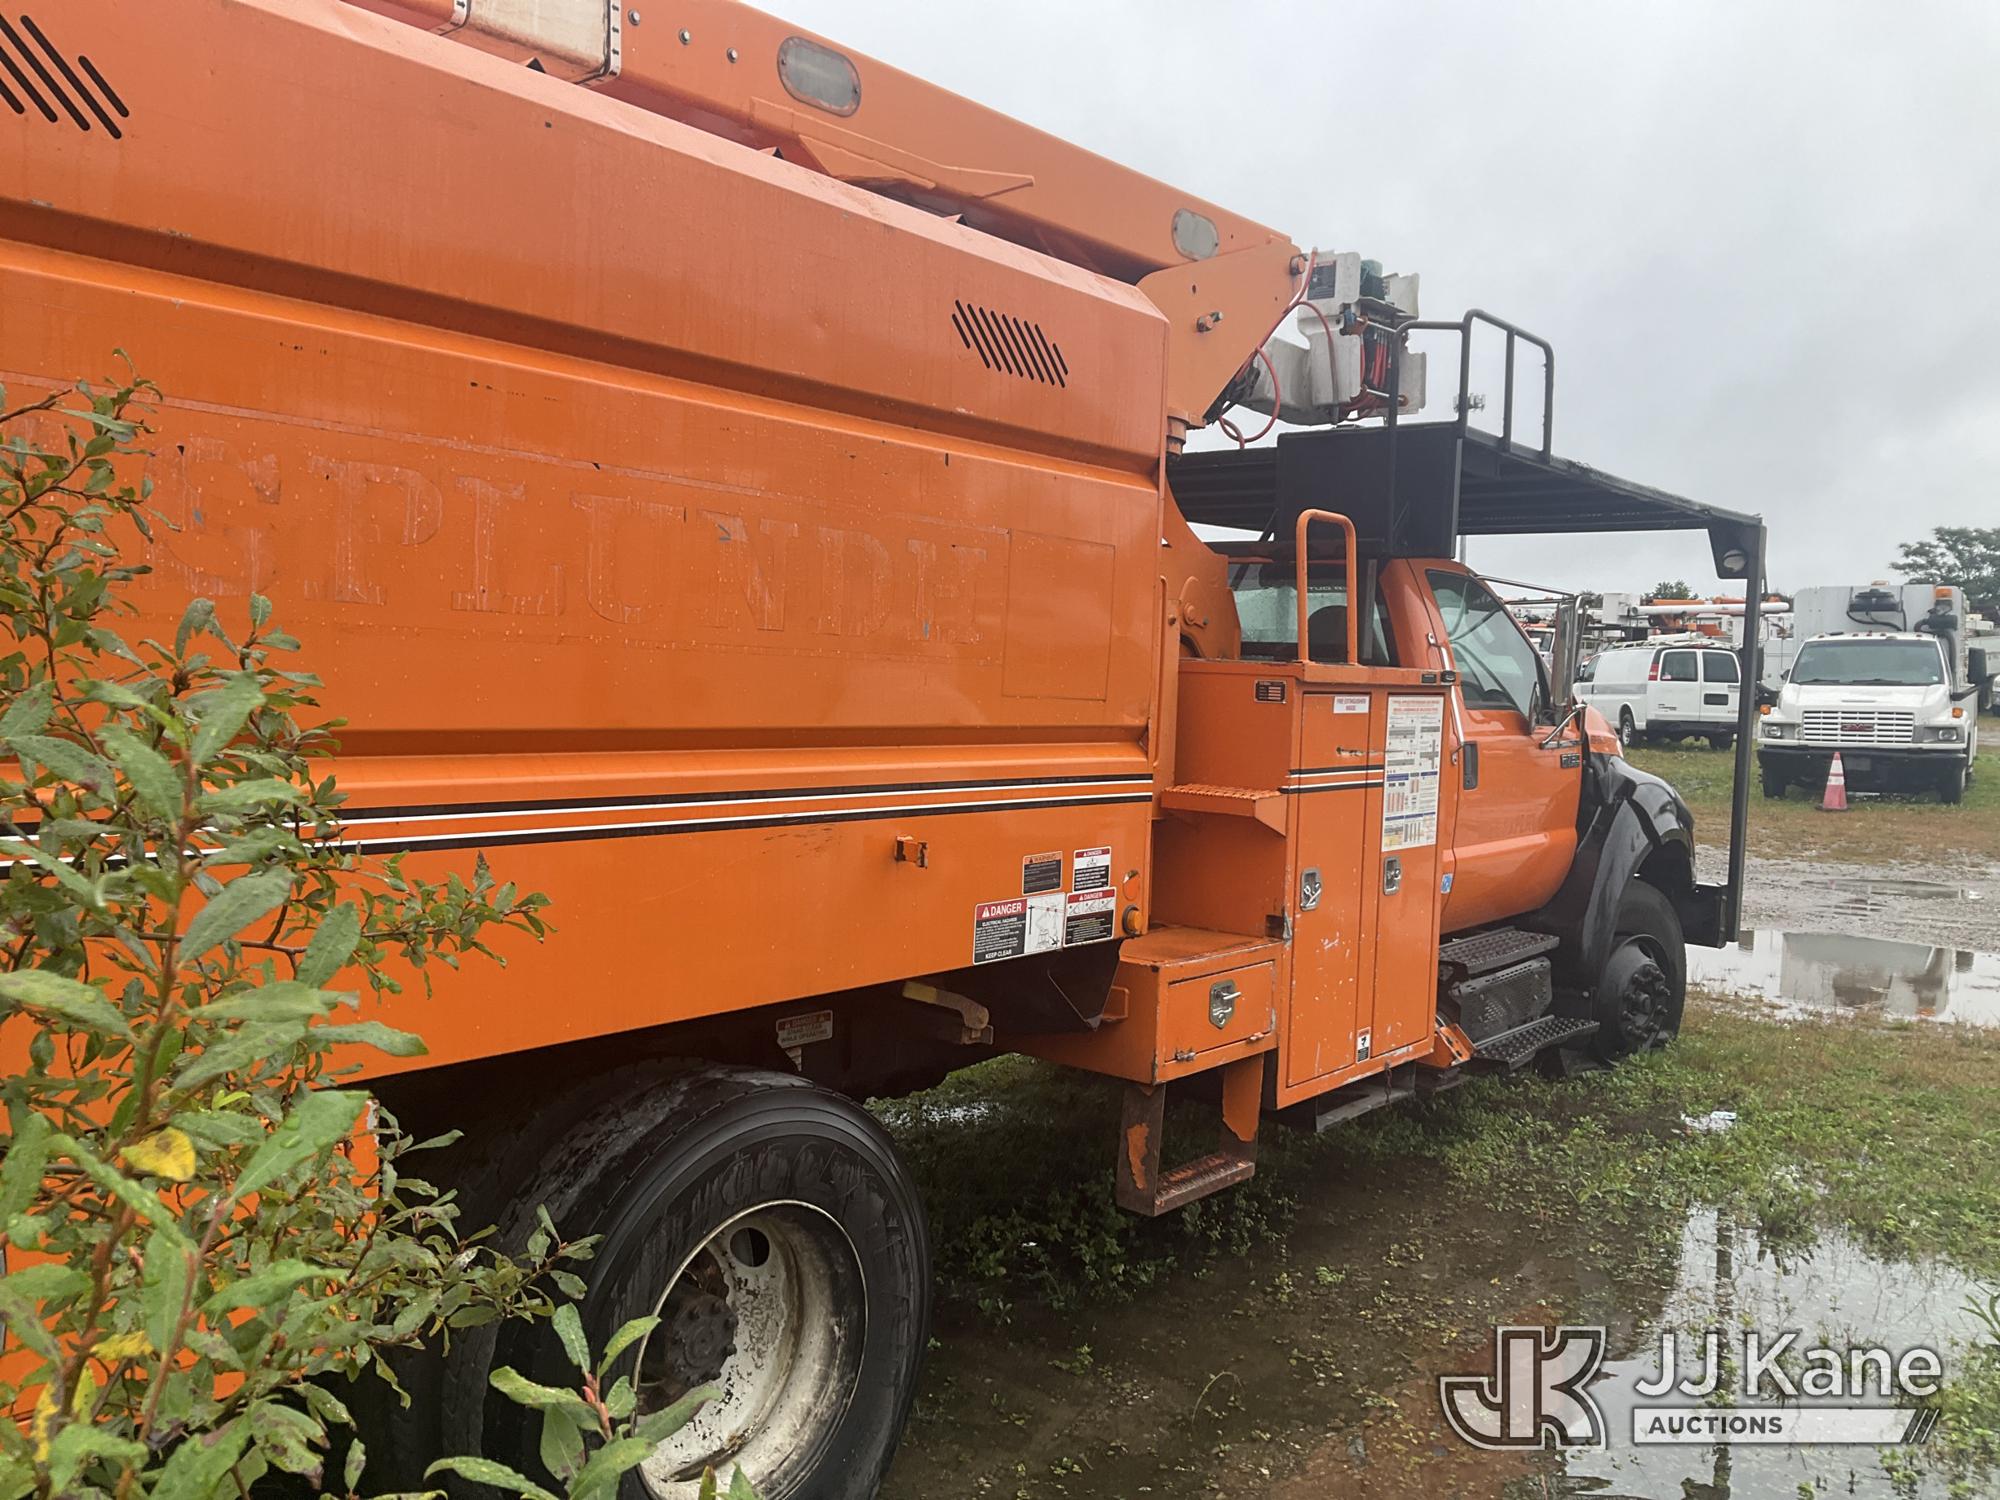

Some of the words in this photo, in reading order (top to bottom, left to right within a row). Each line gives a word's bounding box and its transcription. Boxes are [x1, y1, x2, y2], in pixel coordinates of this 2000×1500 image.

[1842, 723, 1874, 731] GMC
[1084, 892, 1103, 900] DANGER
[990, 902, 1022, 916] DANGER
[985, 951, 997, 959] KEEP
[997, 949, 1012, 957] CLEAR
